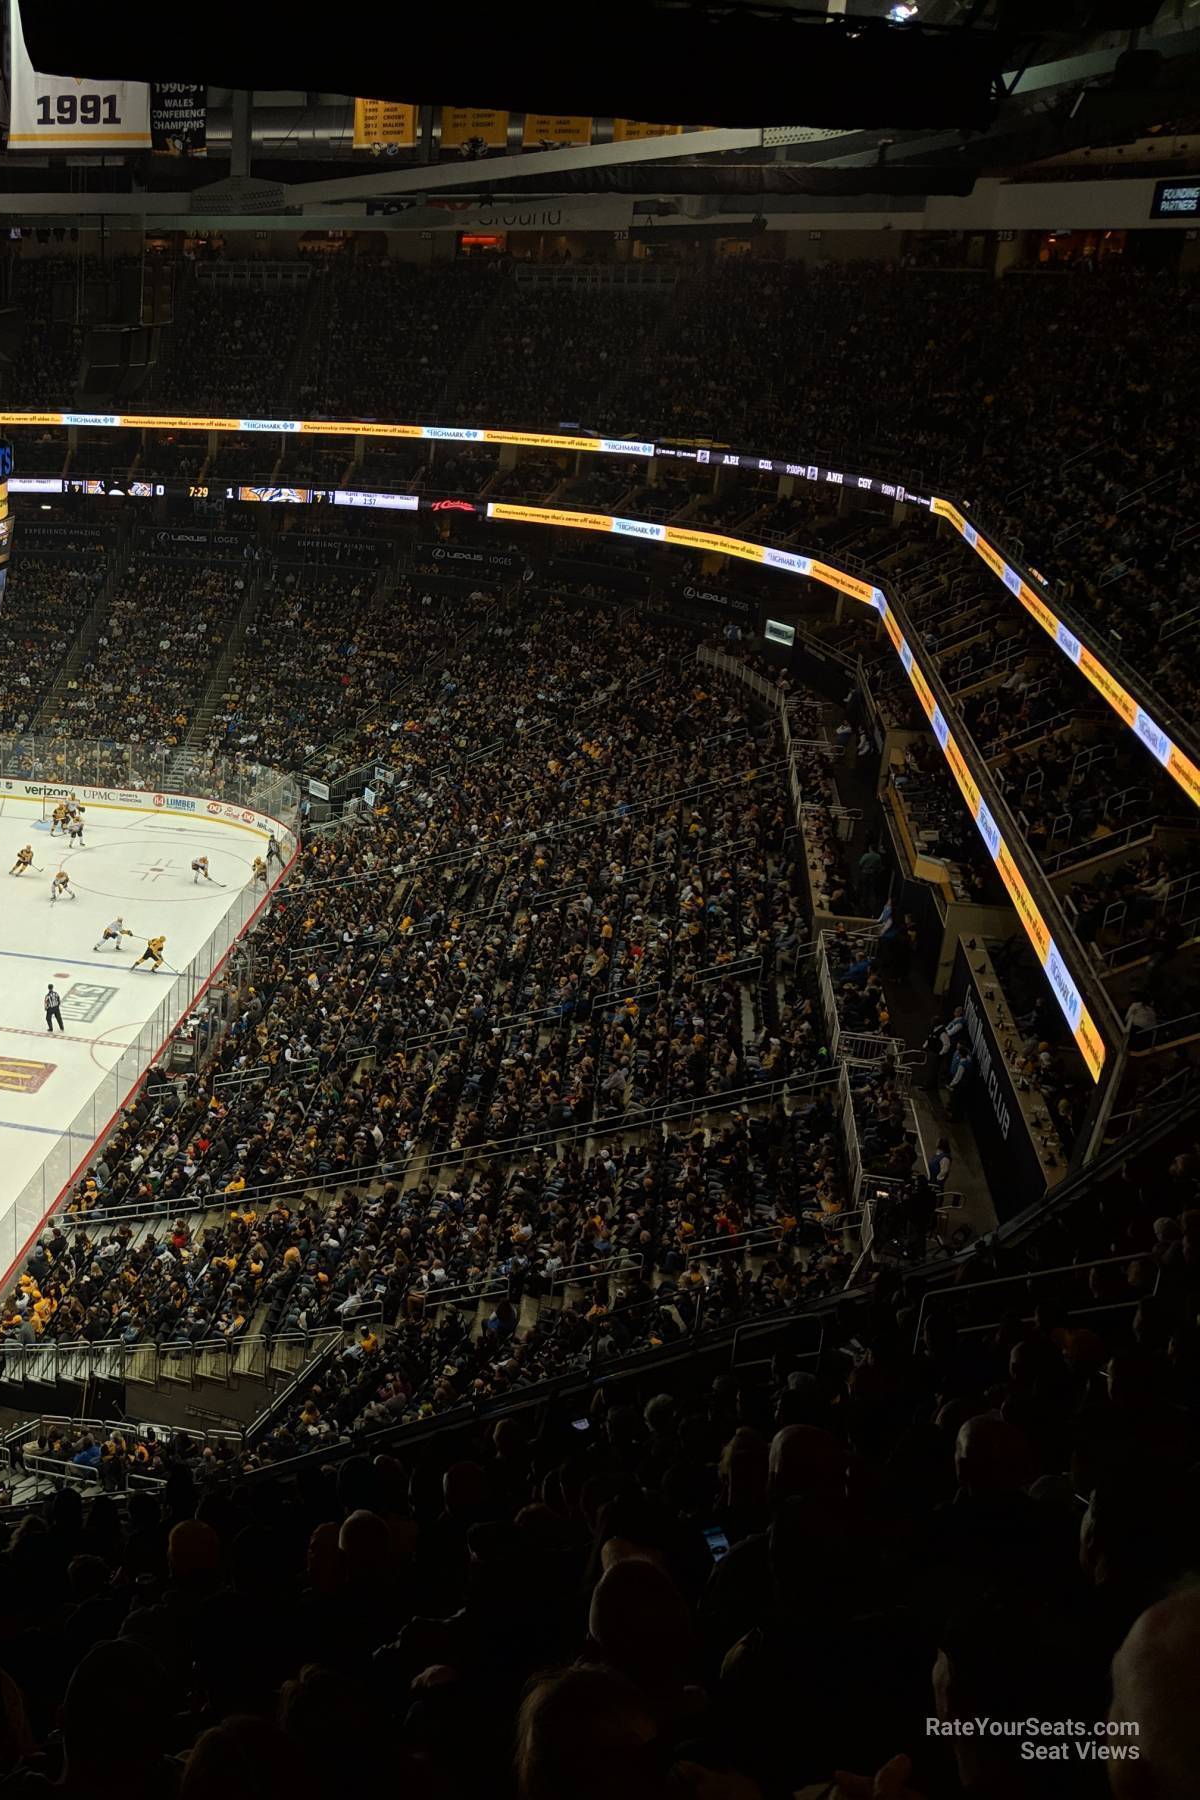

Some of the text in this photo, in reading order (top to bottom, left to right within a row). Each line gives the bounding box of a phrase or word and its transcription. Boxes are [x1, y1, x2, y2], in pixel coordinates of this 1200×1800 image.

[164, 98, 194, 107] WALES
[37, 94, 122, 125] 1991
[152, 108, 206, 119] CONFERENCE
[153, 120, 205, 130] CHAMPIONS
[1160, 200, 1198, 211] PARTNERS
[608, 442, 642, 453] HIGHMARK
[723, 456, 740, 466] ARI
[759, 459, 773, 470] COL
[826, 474, 843, 483] ANH
[858, 478, 873, 489] CGY
[156, 484, 165, 496] 0
[188, 486, 209, 498] 7:29
[226, 488, 234, 499] 1
[170, 534, 240, 545] LEXUS LOGES
[446, 551, 483, 561] LEXUS
[25, 785, 68, 797] verizon
[83, 789, 116, 801] UPMC
[153, 796, 196, 807] 84 LUMBER
[988, 1069, 1011, 1142] CLUB
